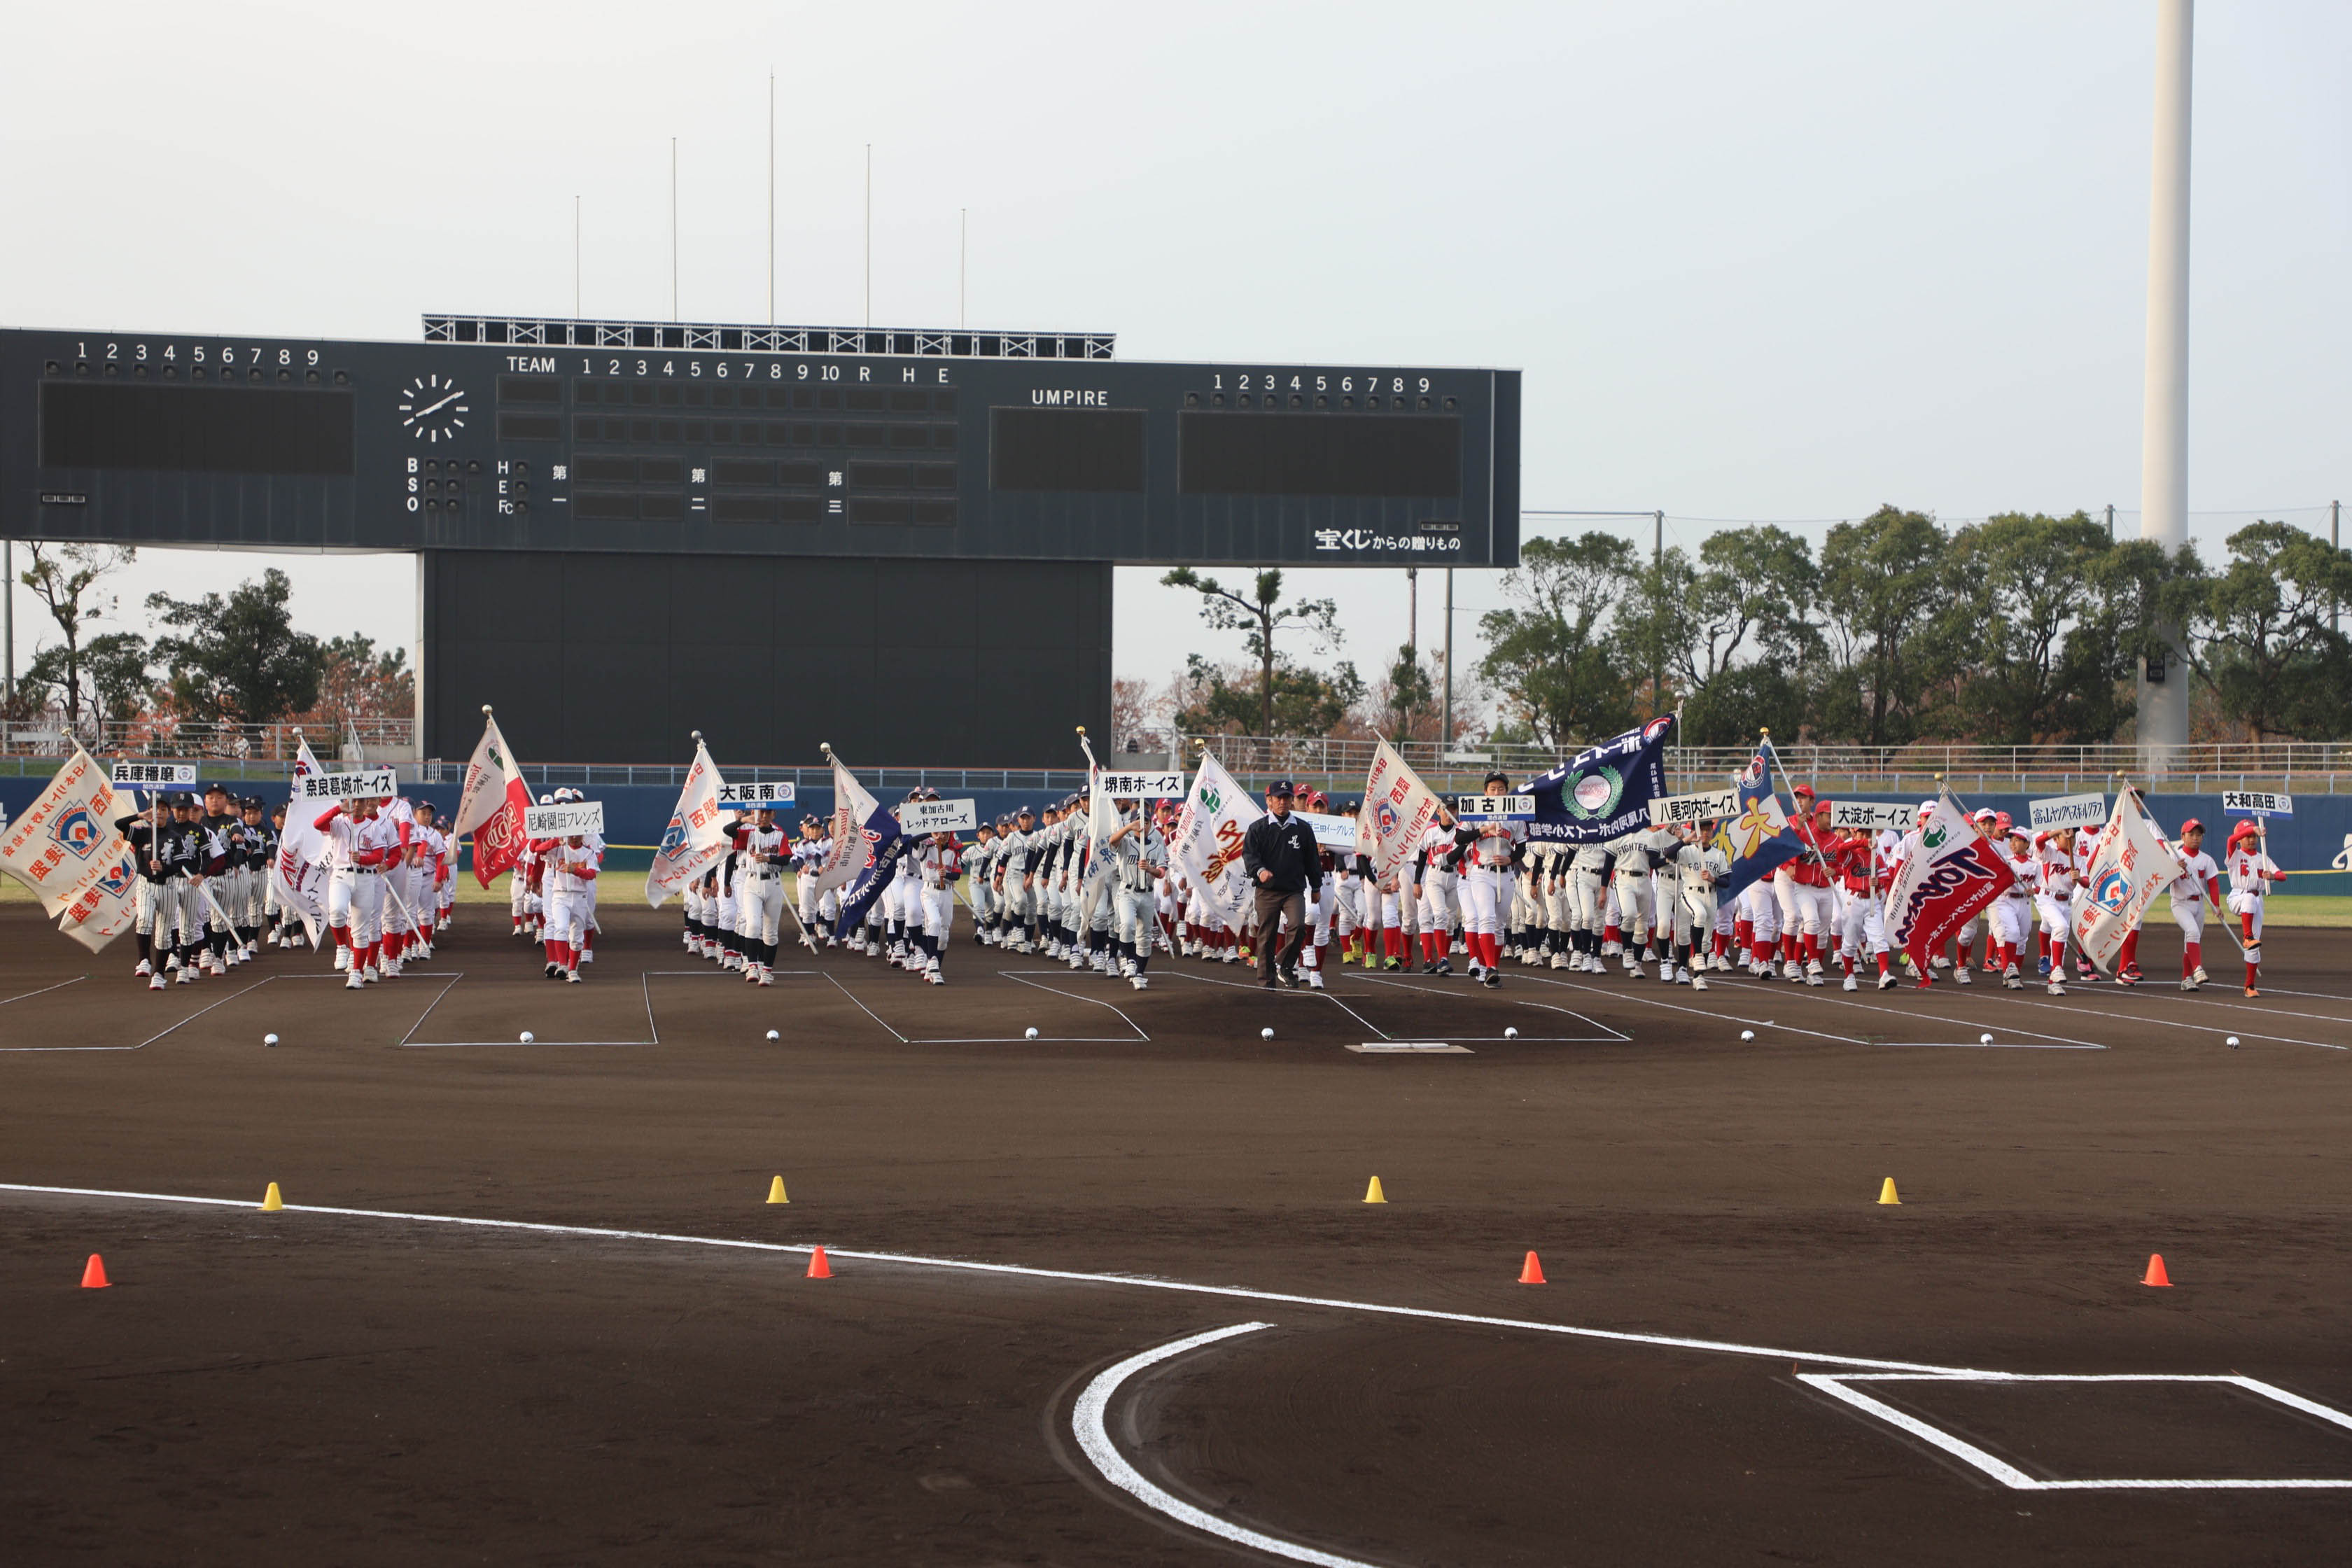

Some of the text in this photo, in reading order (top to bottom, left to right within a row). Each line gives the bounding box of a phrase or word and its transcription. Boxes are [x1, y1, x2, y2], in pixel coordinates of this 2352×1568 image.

[78, 342, 318, 366] 1 2 3 4 5 6 7 8 9
[506, 356, 948, 384] TEAM 1 2 3 4 5 6 7 8 9 10 R H E
[1214, 374, 1429, 393] 1 2 3 4 5 6 7 8 9
[1032, 389, 1108, 406] UMPIRE
[407, 457, 418, 473] B
[498, 461, 509, 475] H
[407, 477, 418, 492] S
[498, 479, 507, 494] E
[1314, 528, 1461, 551] 宝くじからの贈りもの
[114, 765, 174, 782] 兵庫播磨
[305, 773, 391, 797] 奈良葛城ボーイズ
[720, 784, 775, 801] 大阪南
[1104, 775, 1180, 793] 堺南ボーイズ
[920, 804, 954, 815] 東加古川
[1460, 797, 1516, 813] 加古川
[1660, 793, 1737, 822] 八尾河内ボーイズ
[2225, 792, 2276, 810] 大和高田
[528, 807, 601, 832] 尼崎園田フレンズ
[1838, 806, 1912, 826] 大淀ボーイズ
